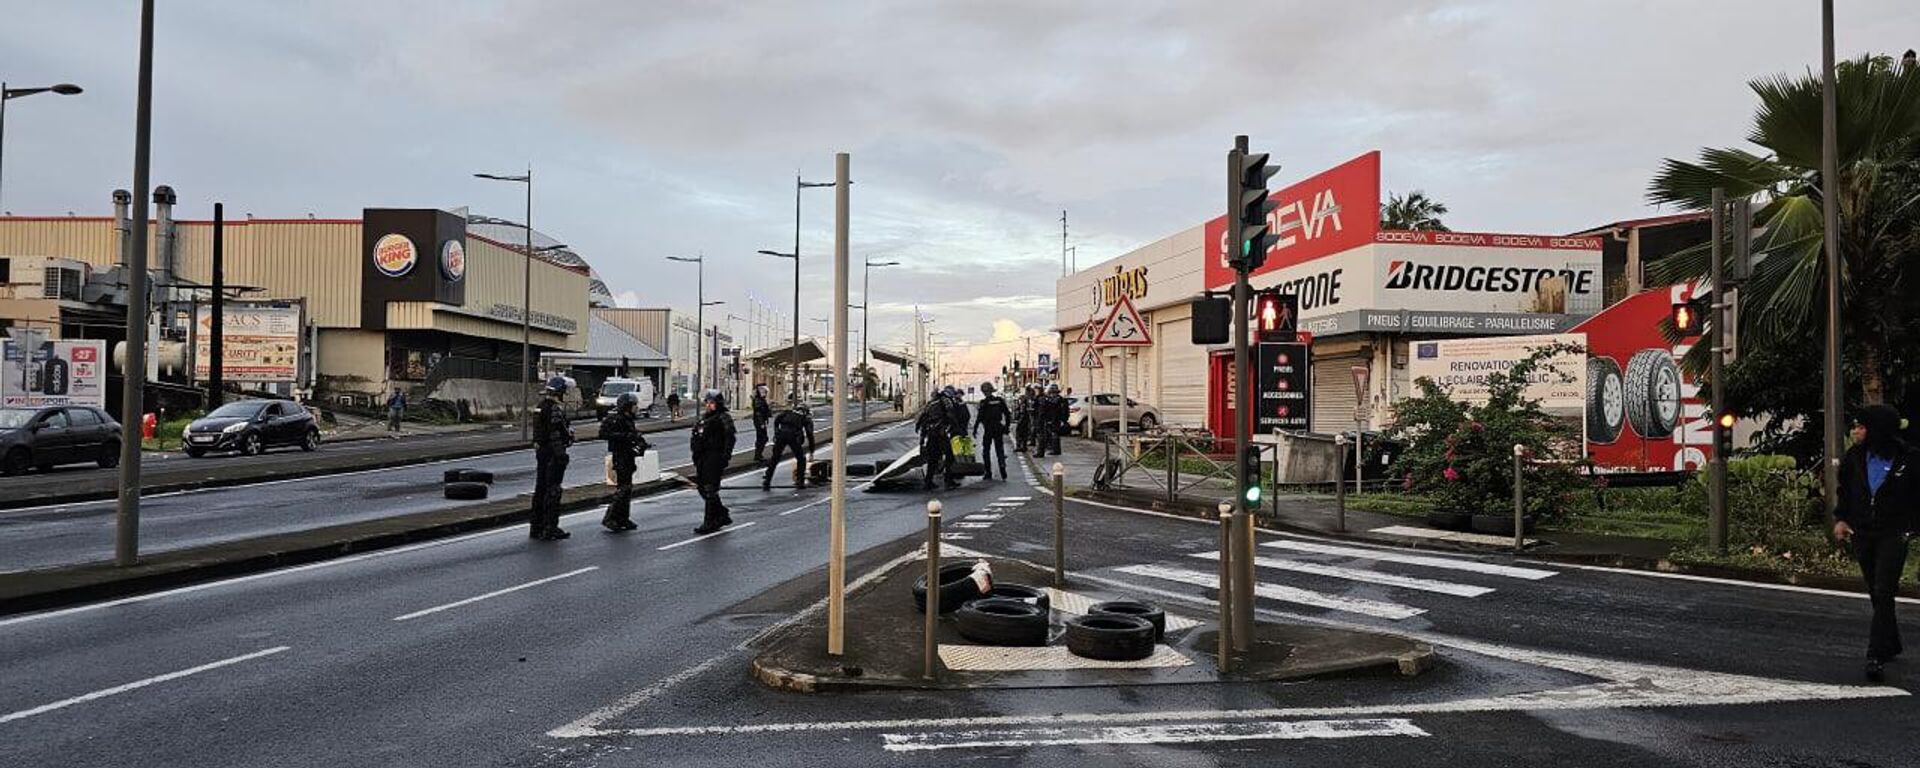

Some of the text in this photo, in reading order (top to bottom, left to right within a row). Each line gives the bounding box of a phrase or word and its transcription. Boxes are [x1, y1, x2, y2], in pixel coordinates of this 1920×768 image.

[1376, 232, 1600, 248] SODEVA SODEVA SODEVA SODEVA
[380, 249, 410, 265] KING
[1367, 314, 1400, 327] PNEUS
[1411, 315, 1475, 328] EQUILIBRAGE
[1485, 317, 1555, 329] PARALLELISME
